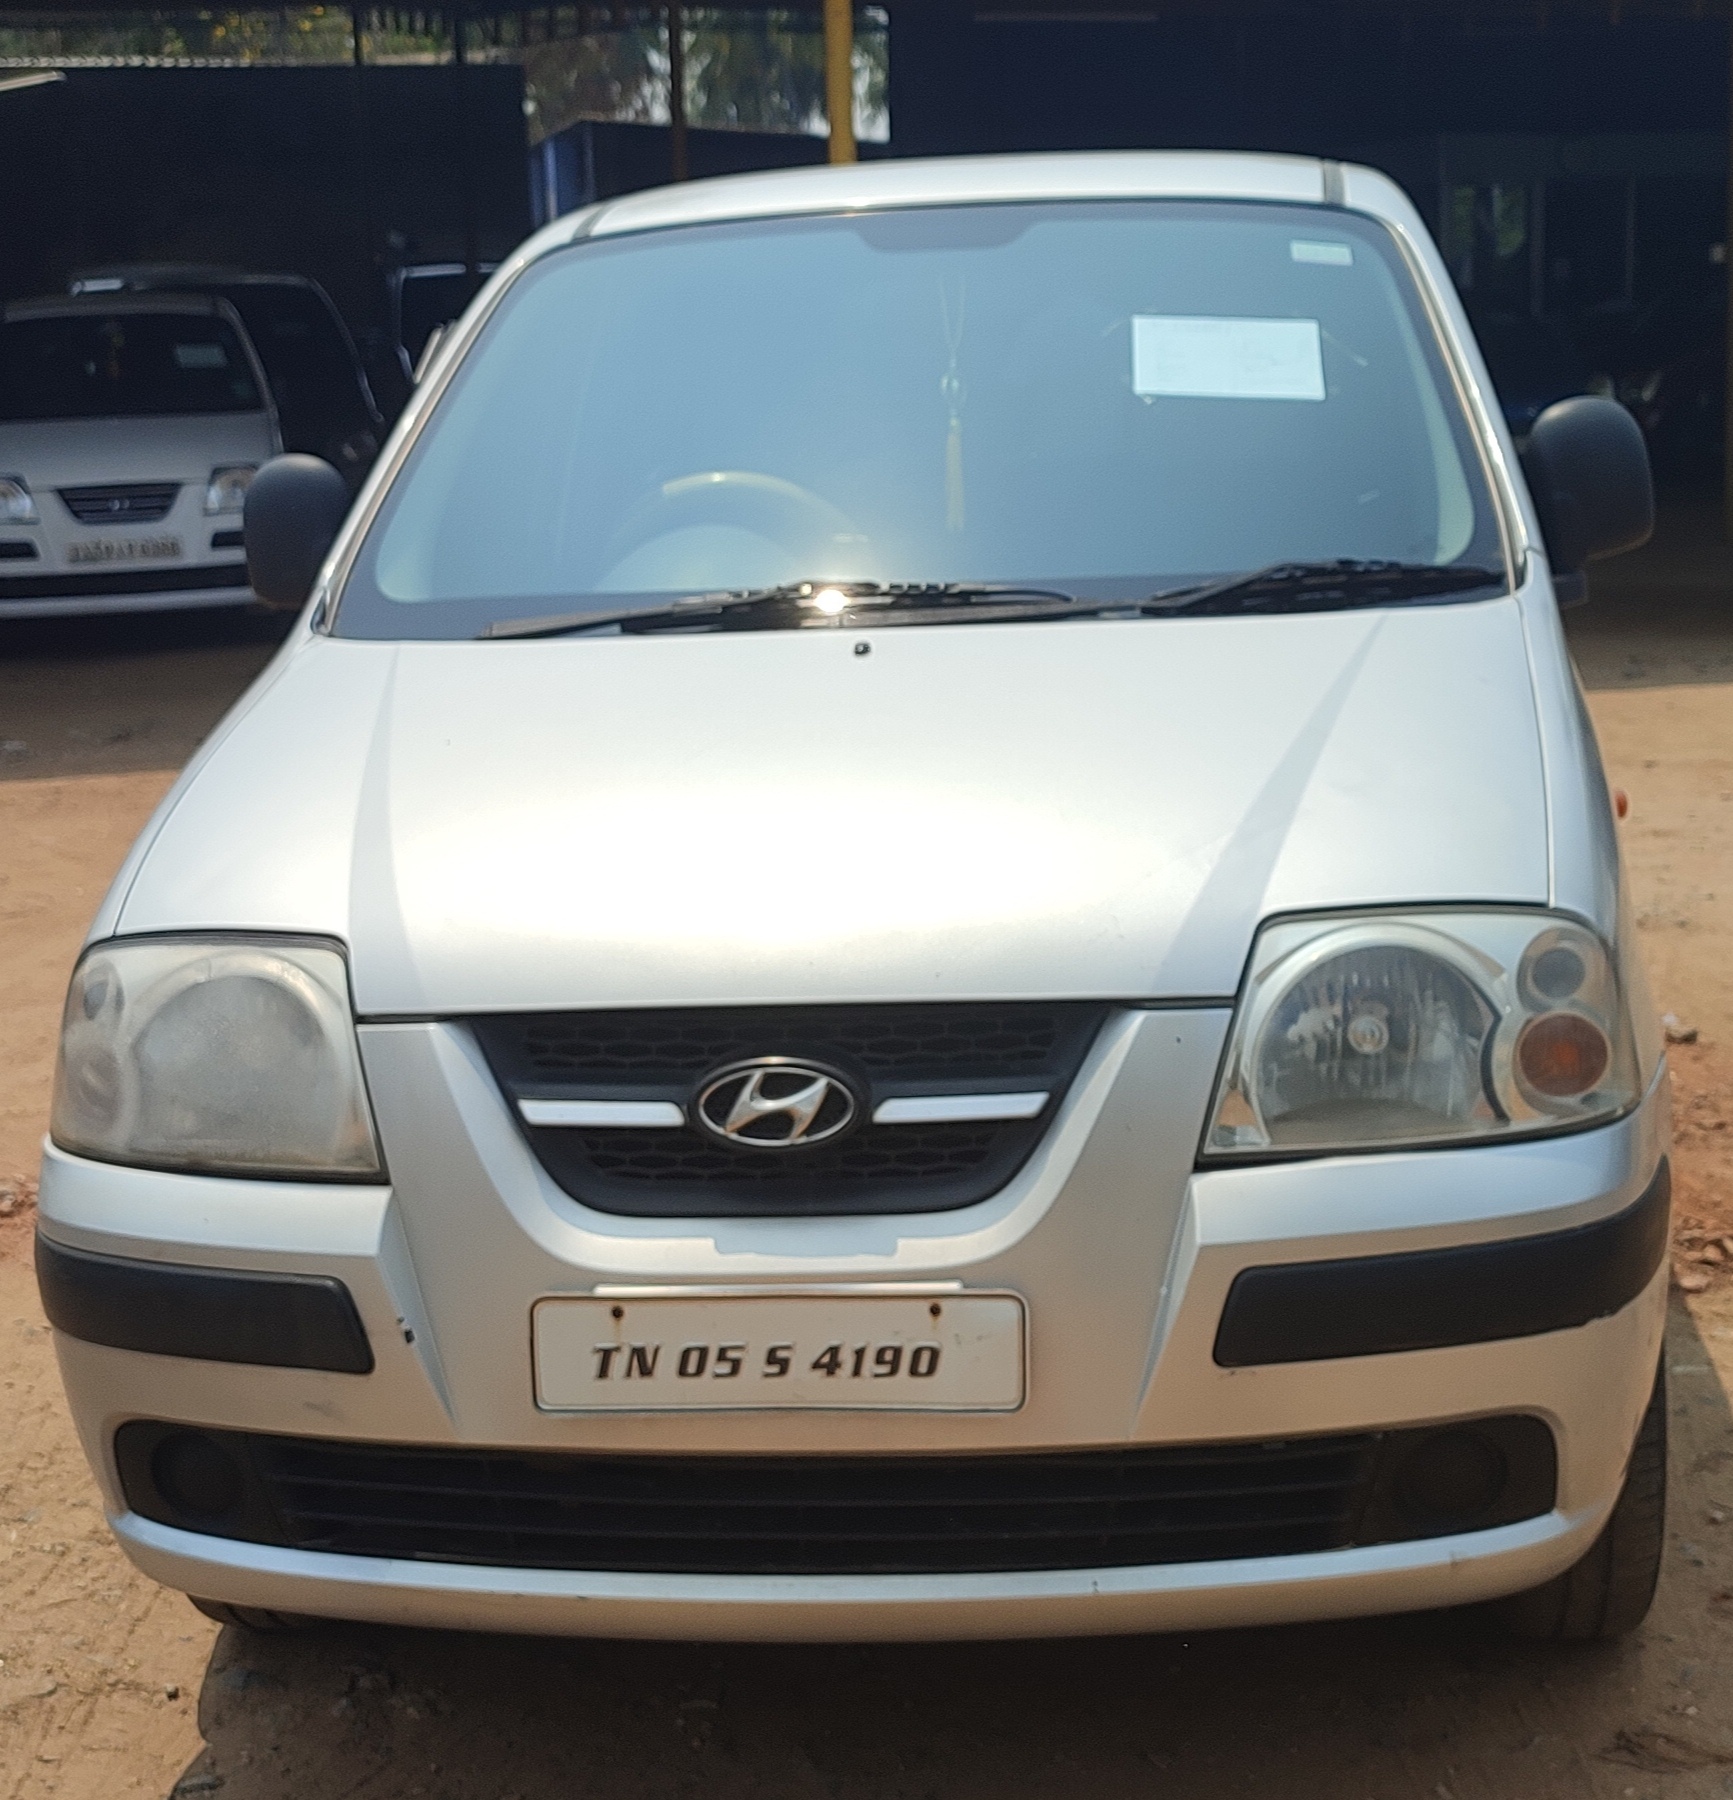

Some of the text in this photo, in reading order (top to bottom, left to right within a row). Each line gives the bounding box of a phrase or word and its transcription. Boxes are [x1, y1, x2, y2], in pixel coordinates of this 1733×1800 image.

[594, 1342, 943, 1379] TN 05 S 4190
